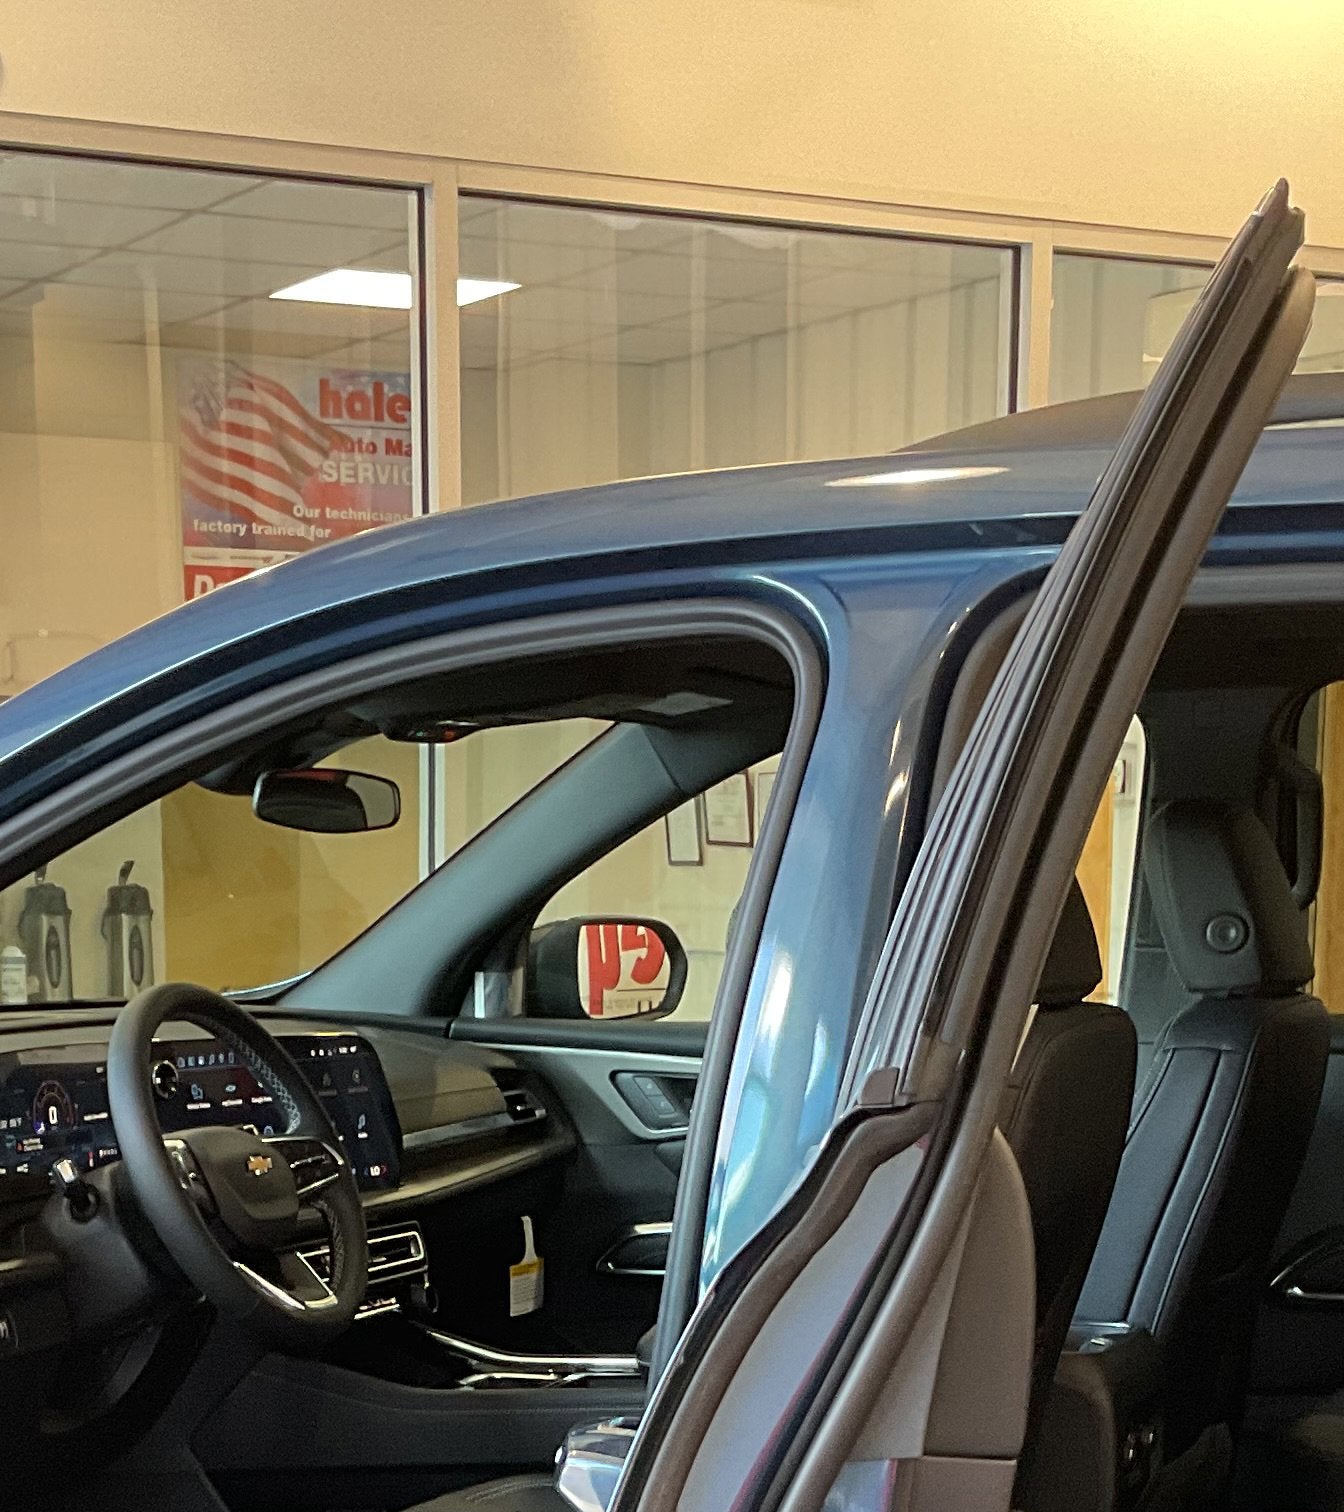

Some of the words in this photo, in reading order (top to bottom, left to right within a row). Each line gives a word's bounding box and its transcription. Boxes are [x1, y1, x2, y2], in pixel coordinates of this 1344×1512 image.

[292, 504, 320, 518] Our
[193, 518, 247, 537] factory
[252, 523, 306, 538] trained
[308, 524, 332, 542] for
